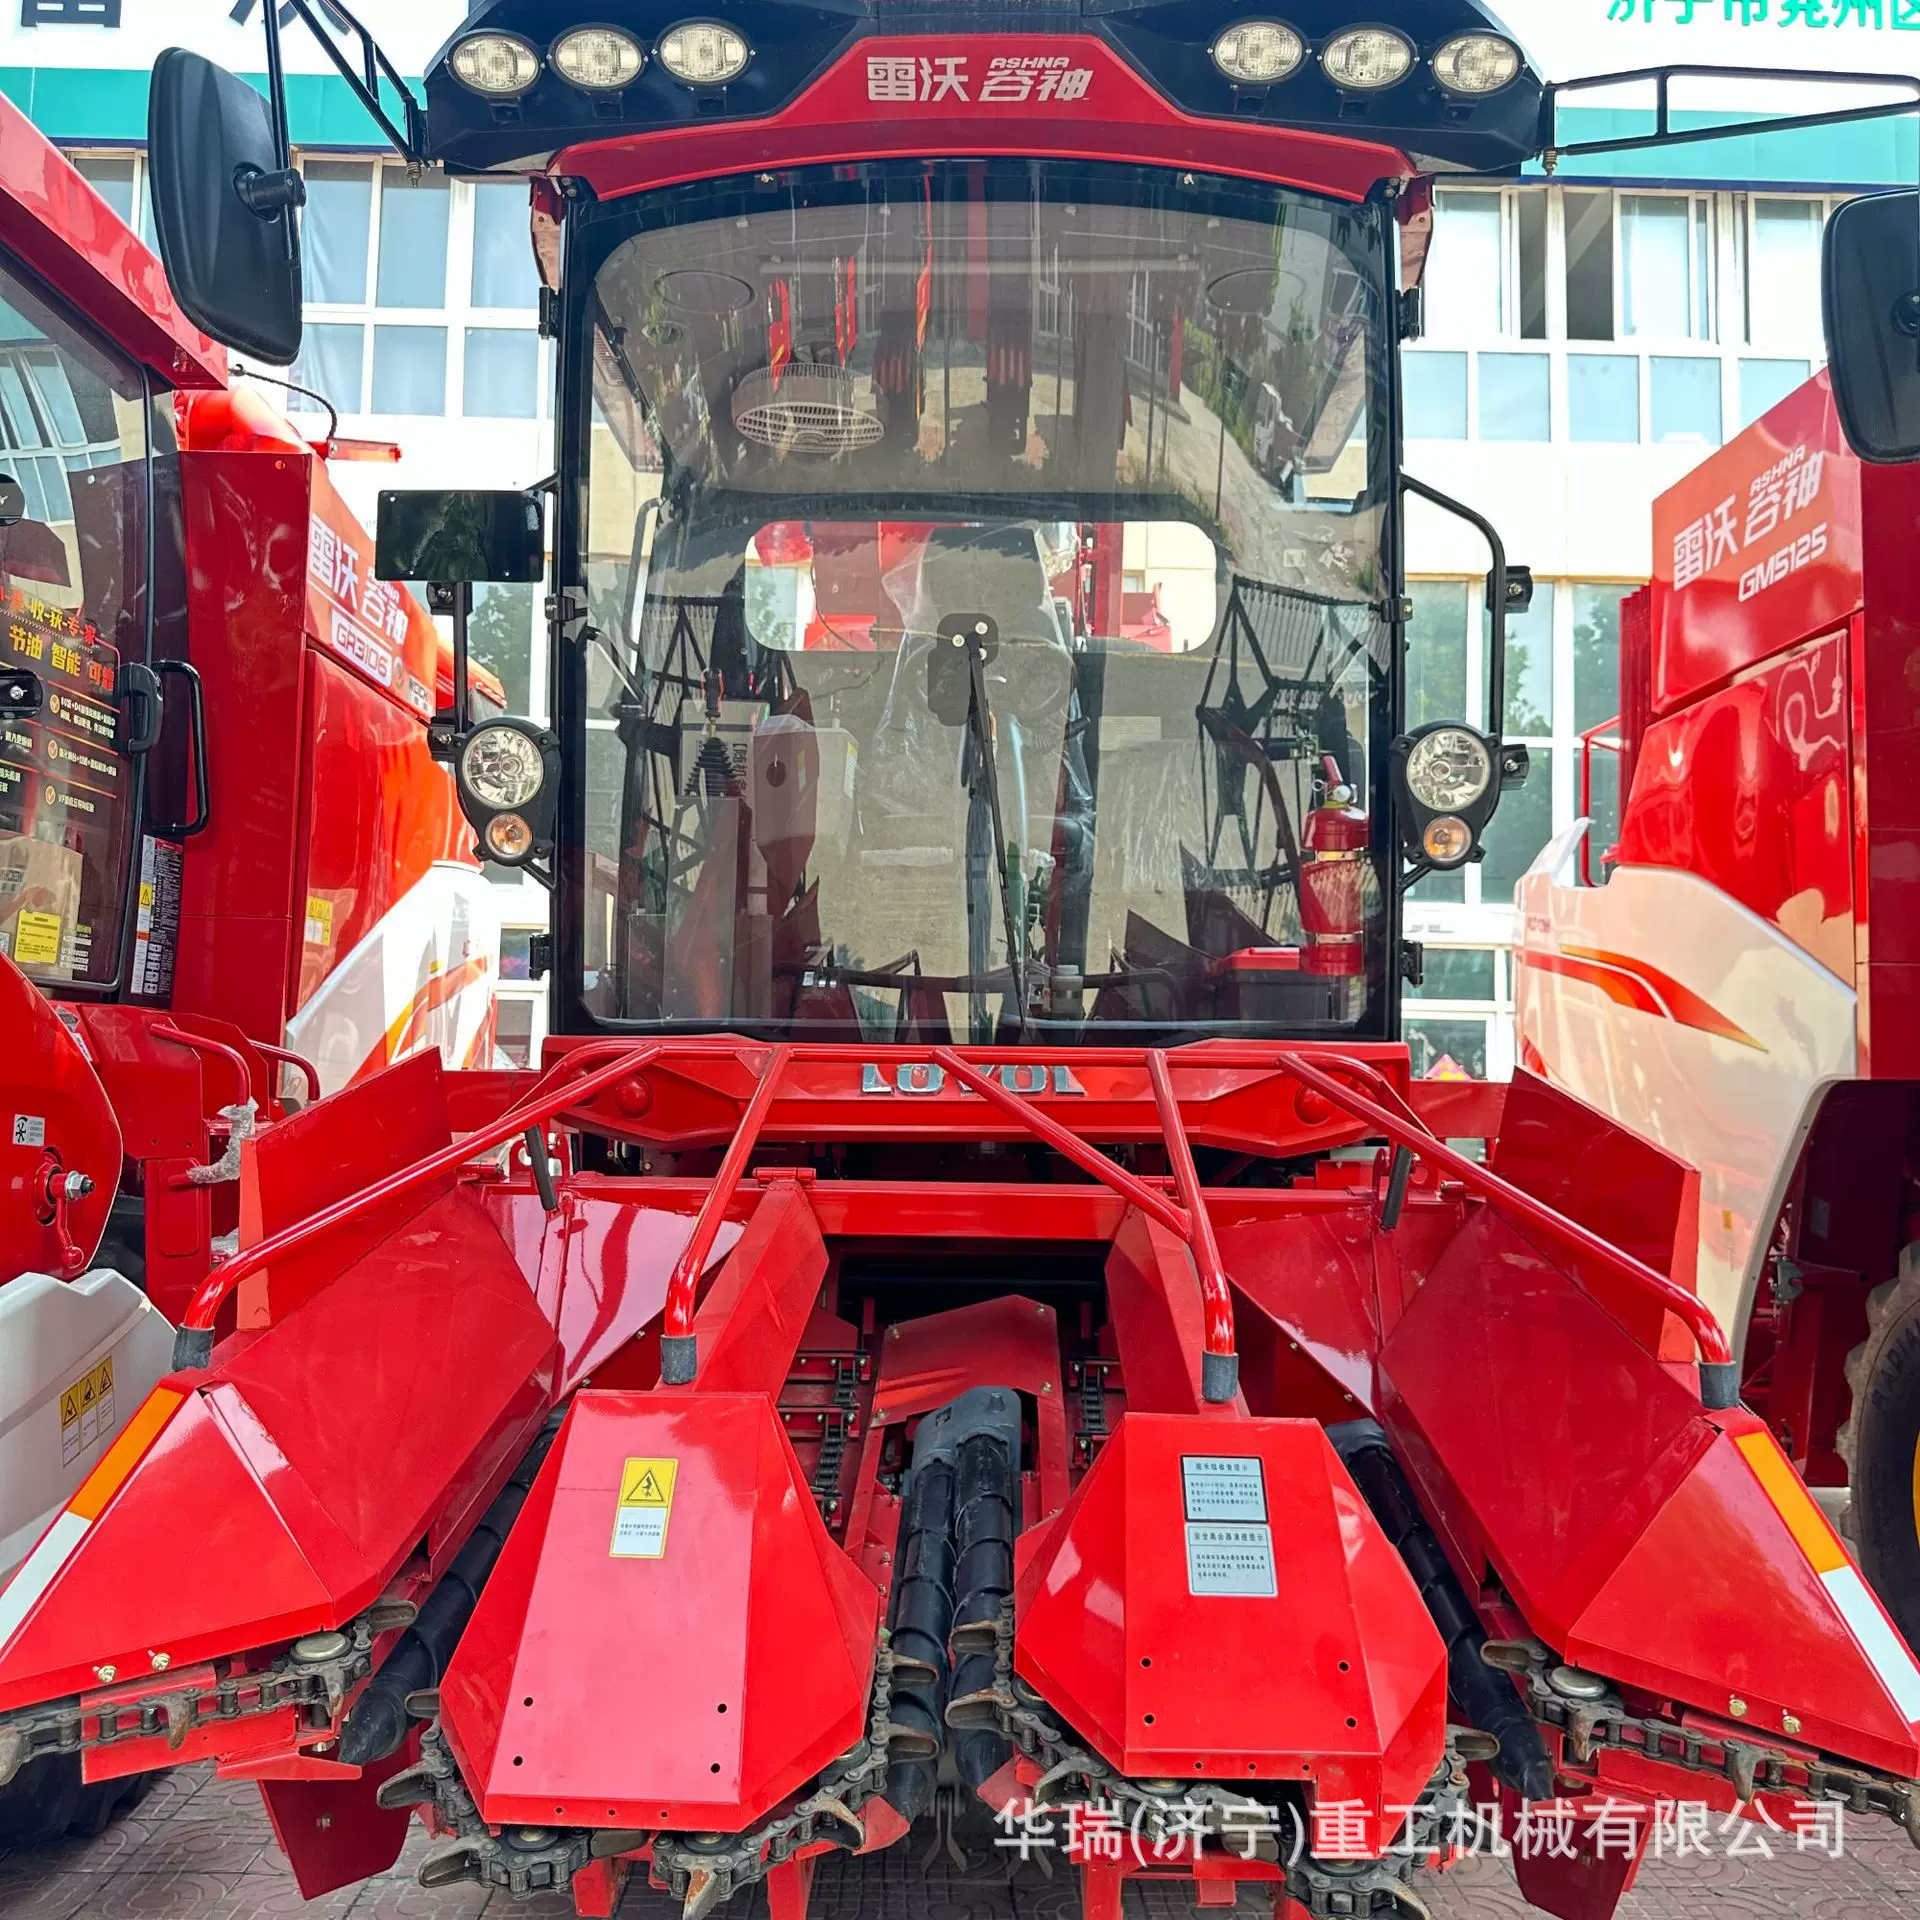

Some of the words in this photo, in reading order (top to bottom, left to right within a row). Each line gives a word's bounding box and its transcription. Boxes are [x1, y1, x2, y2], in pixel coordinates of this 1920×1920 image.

[867, 56, 971, 101] 雷沃
[978, 69, 1094, 101] 谷神
[990, 57, 1070, 69] ASHNA
[1749, 444, 1806, 496] ASHNA
[1673, 494, 1739, 592] 雷沃
[1743, 450, 1824, 548] 谷神
[308, 512, 360, 611] 雷沃
[361, 579, 409, 645] 谷神
[9, 624, 43, 660] 节油
[51, 642, 82, 678] 智能
